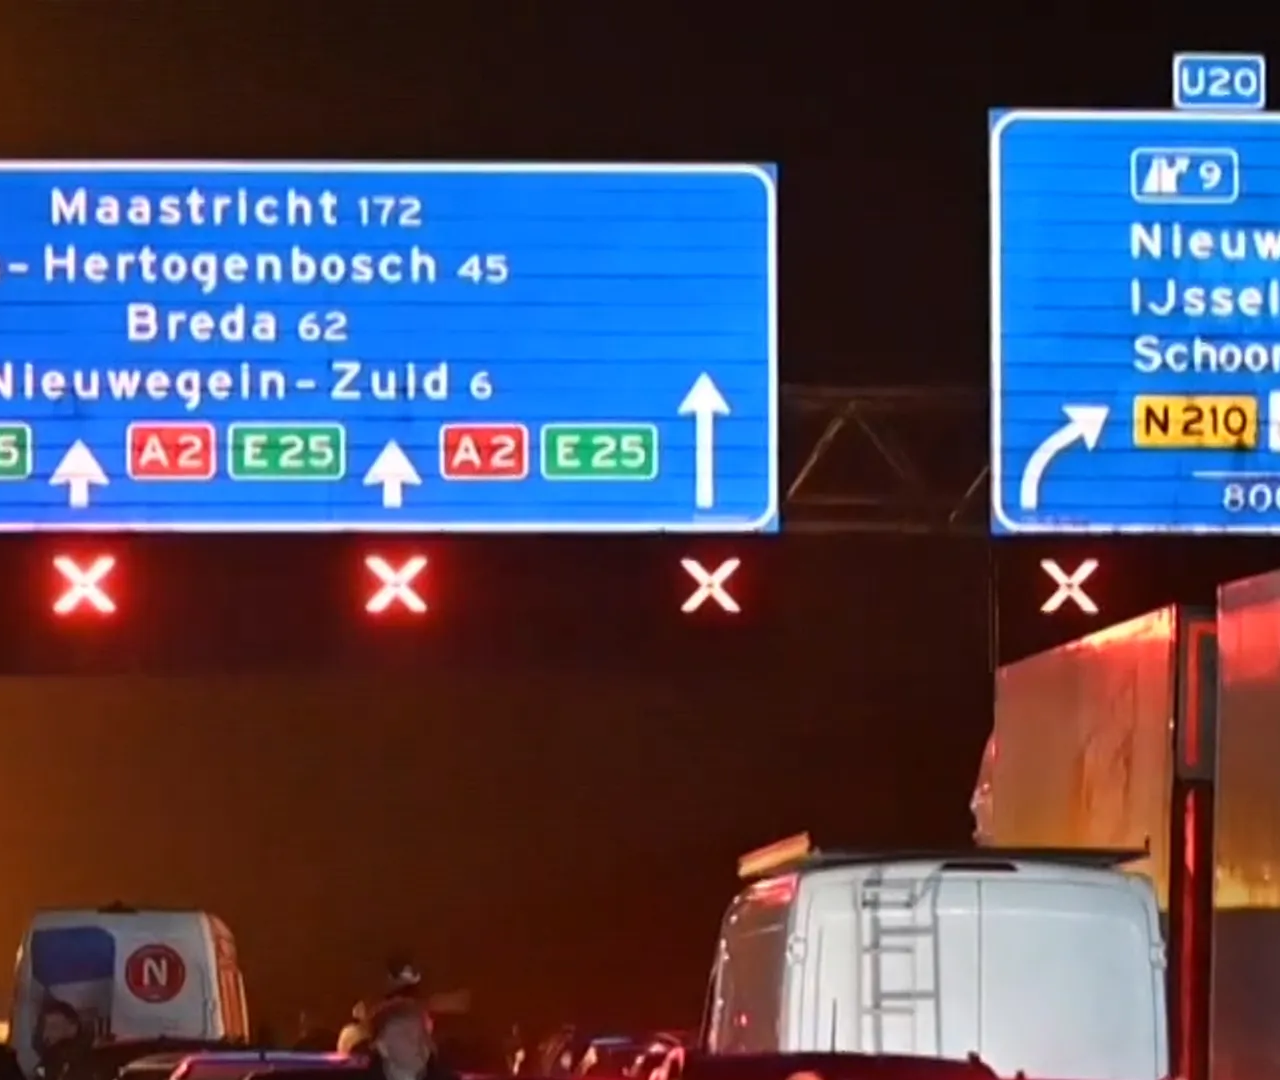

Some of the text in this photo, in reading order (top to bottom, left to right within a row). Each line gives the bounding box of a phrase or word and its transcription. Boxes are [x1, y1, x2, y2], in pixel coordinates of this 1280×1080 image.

[1180, 66, 1258, 97] U20
[1199, 160, 1222, 190] 9
[51, 187, 422, 228] Maastricht 172
[457, 253, 509, 285] 45
[127, 302, 348, 342] Breda 62
[469, 370, 493, 401] 6
[138, 434, 204, 470] A2
[451, 434, 516, 470] A2
[142, 956, 169, 988] N
